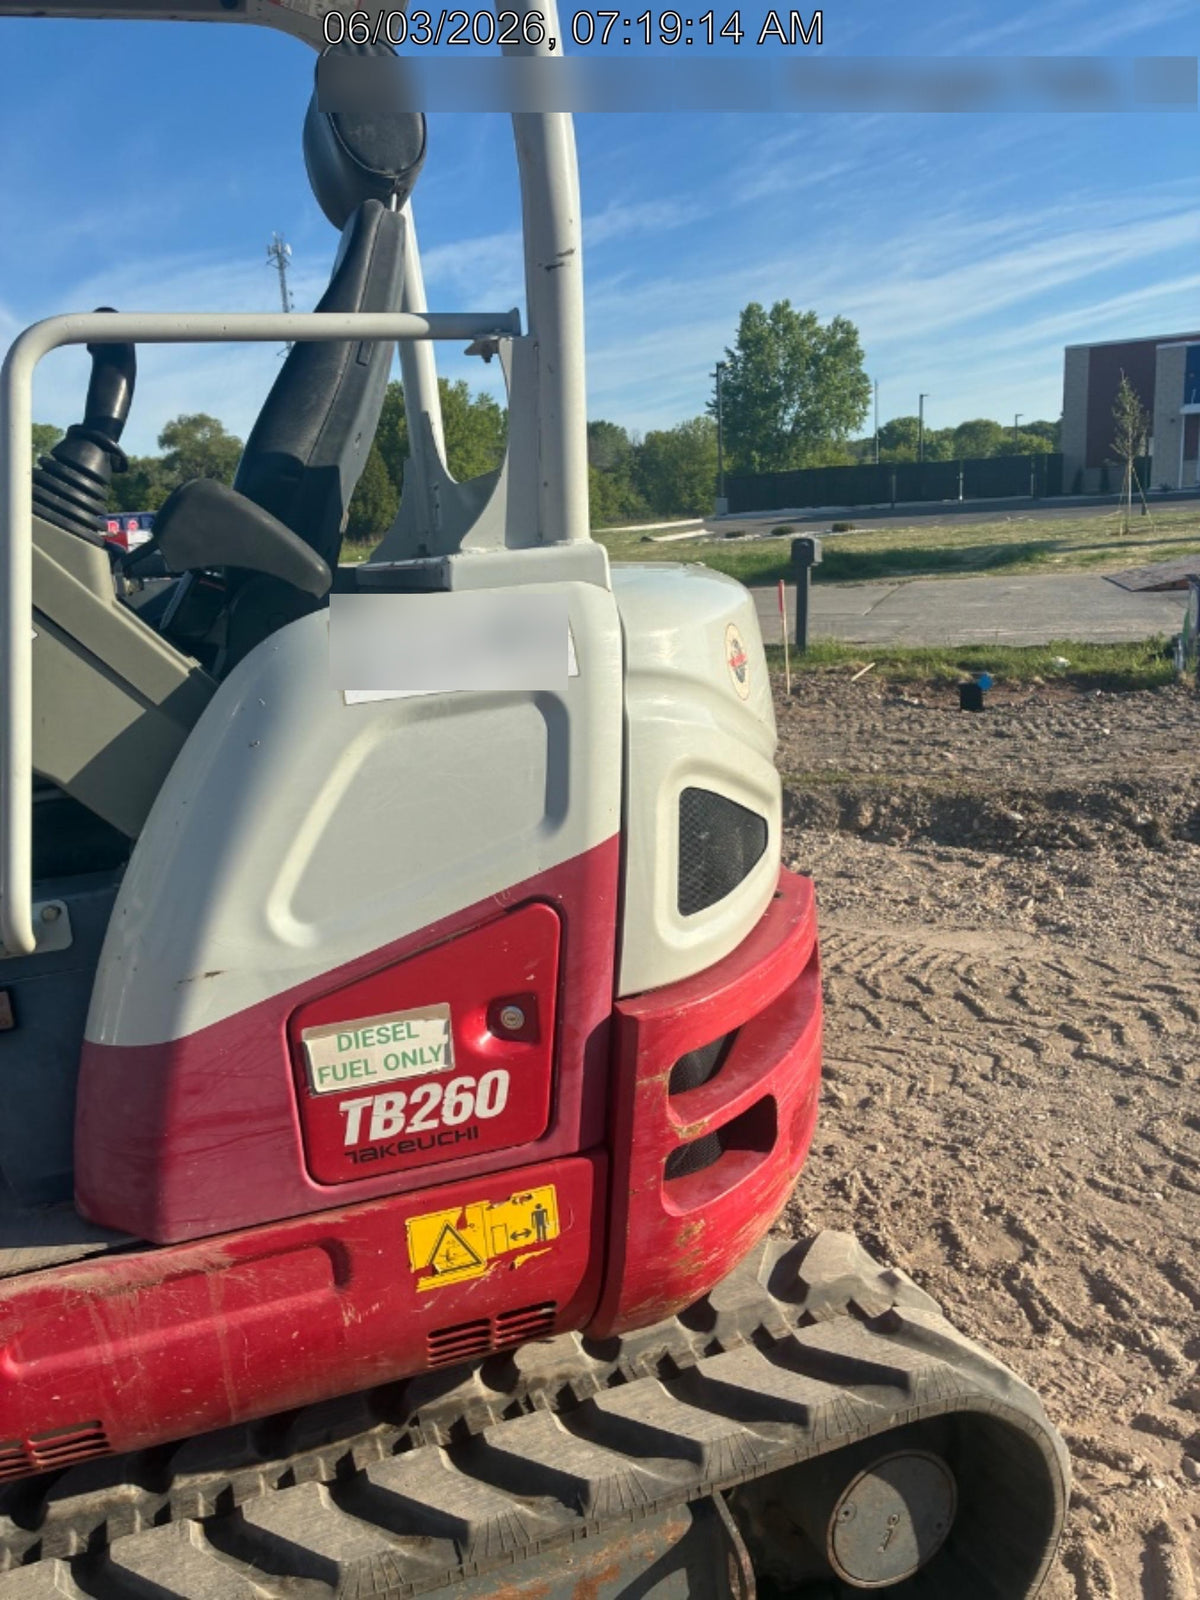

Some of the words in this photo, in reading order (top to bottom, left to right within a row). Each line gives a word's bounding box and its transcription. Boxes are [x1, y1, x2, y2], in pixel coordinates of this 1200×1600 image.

[337, 1021, 419, 1052] DIESEL
[317, 1058, 377, 1084] FUEL
[383, 1044, 442, 1071] ONLY
[339, 1069, 510, 1146] TB260
